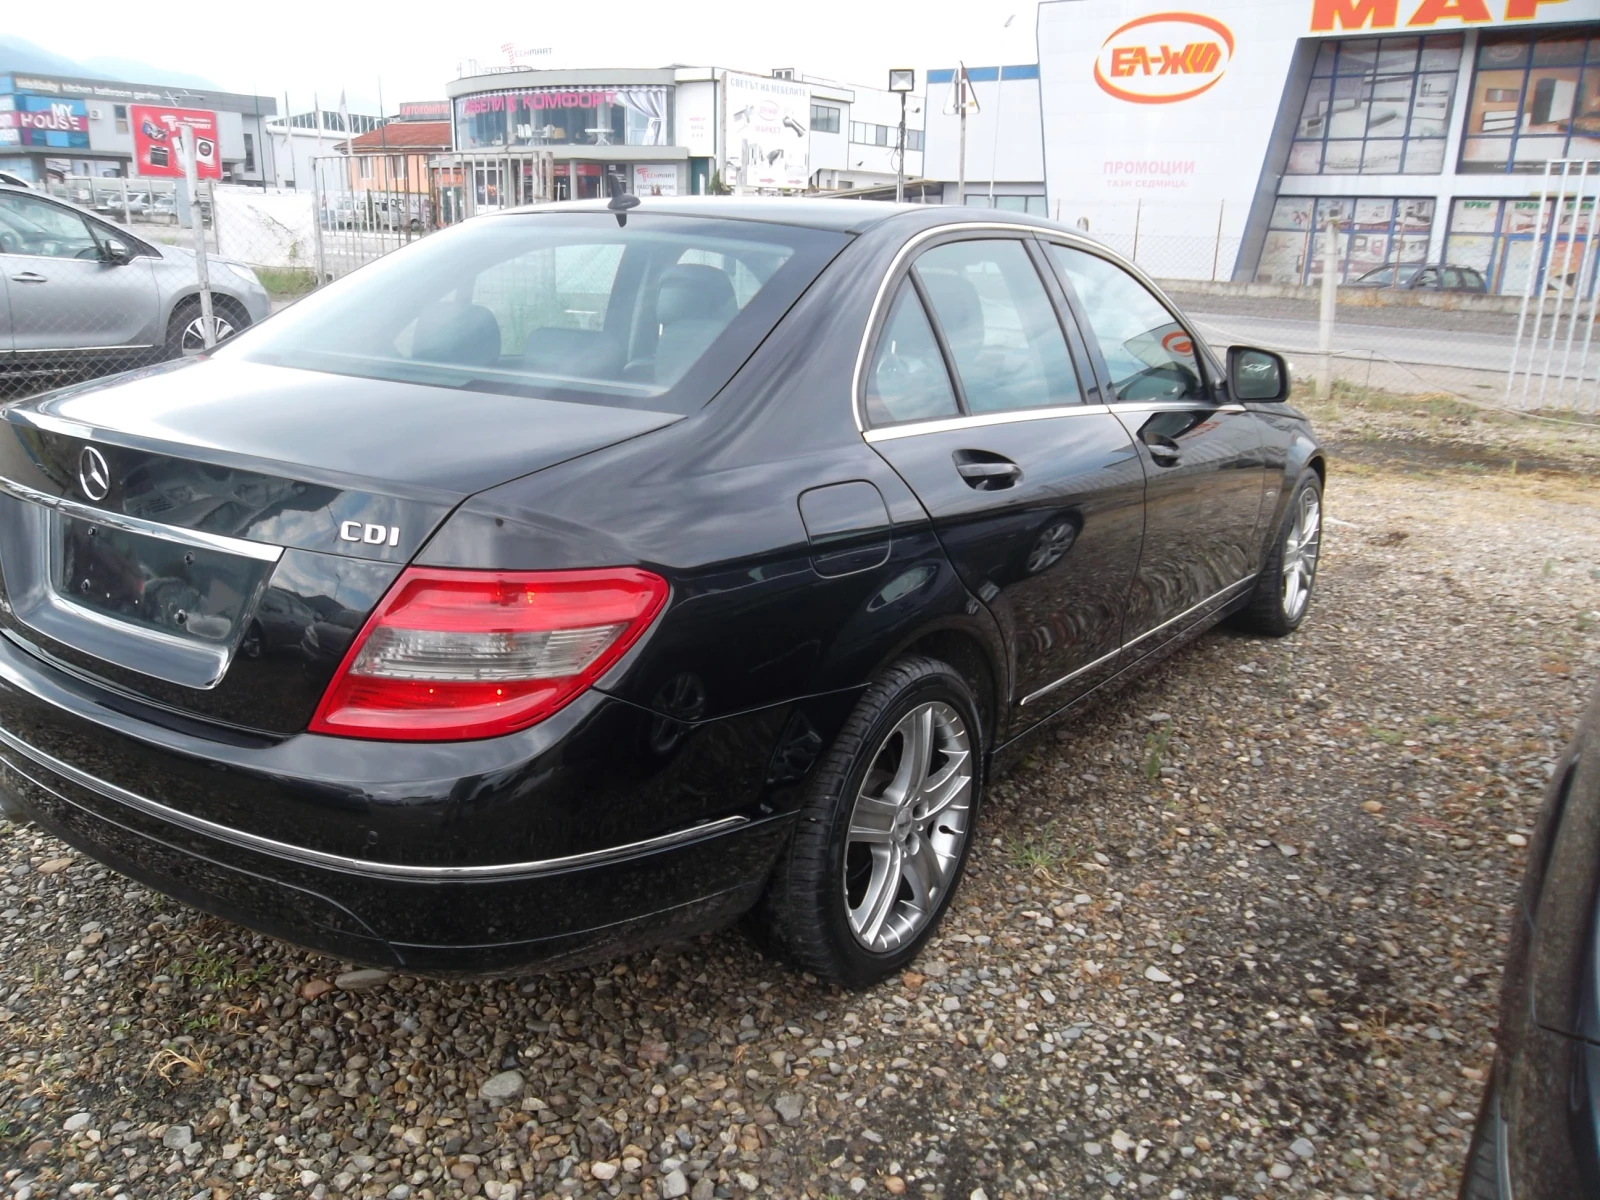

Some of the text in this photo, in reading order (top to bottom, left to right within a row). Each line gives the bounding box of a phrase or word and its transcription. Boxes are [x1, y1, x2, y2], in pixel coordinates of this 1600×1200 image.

[94, 86, 132, 98] bathroom
[761, 83, 770, 92] НА
[771, 85, 806, 97] МЕБЕЛИТЕ
[523, 90, 616, 110] КОМФОРТ
[51, 103, 73, 117] MY
[20, 113, 80, 130] HOUSE
[1103, 160, 1195, 176] ПРОМОЦИИ
[1106, 179, 1133, 188] ТАЗИ
[340, 520, 400, 547] CDI
